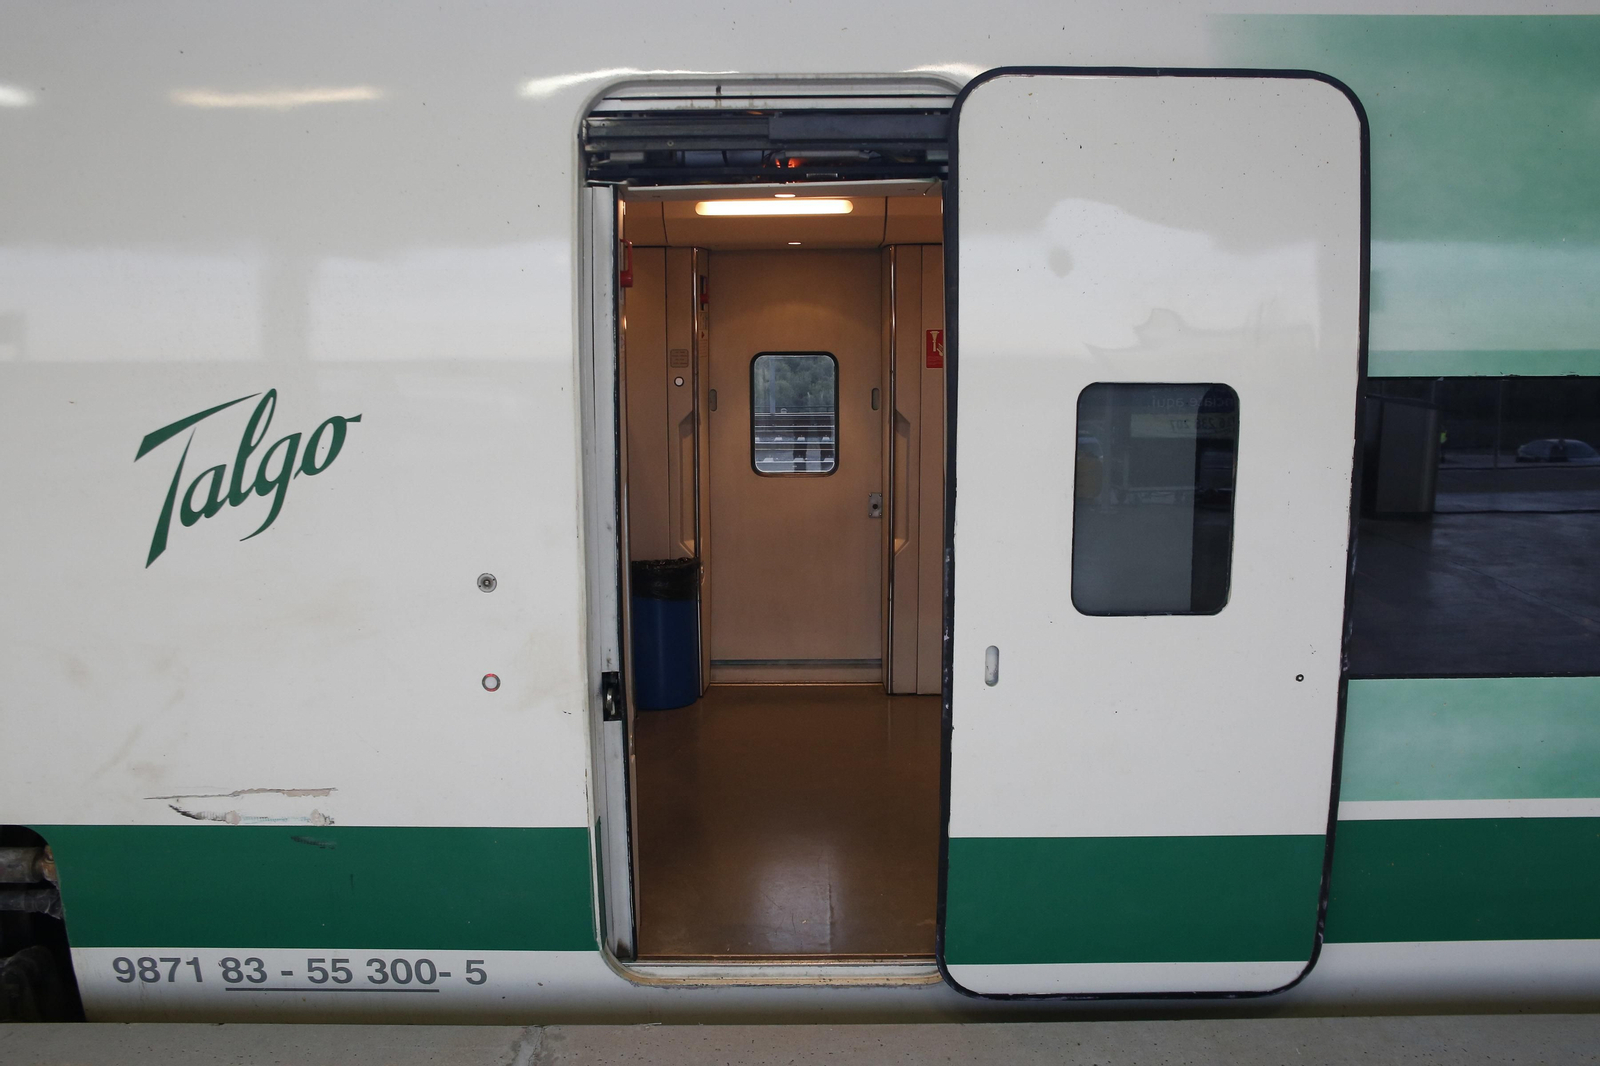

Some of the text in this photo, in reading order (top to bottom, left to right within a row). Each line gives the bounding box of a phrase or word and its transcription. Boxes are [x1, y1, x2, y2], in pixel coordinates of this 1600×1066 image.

[134, 388, 363, 569] Talgo
[112, 956, 203, 983] 9871
[221, 957, 268, 984] 83
[307, 958, 353, 984] 55
[465, 959, 488, 985] 5
